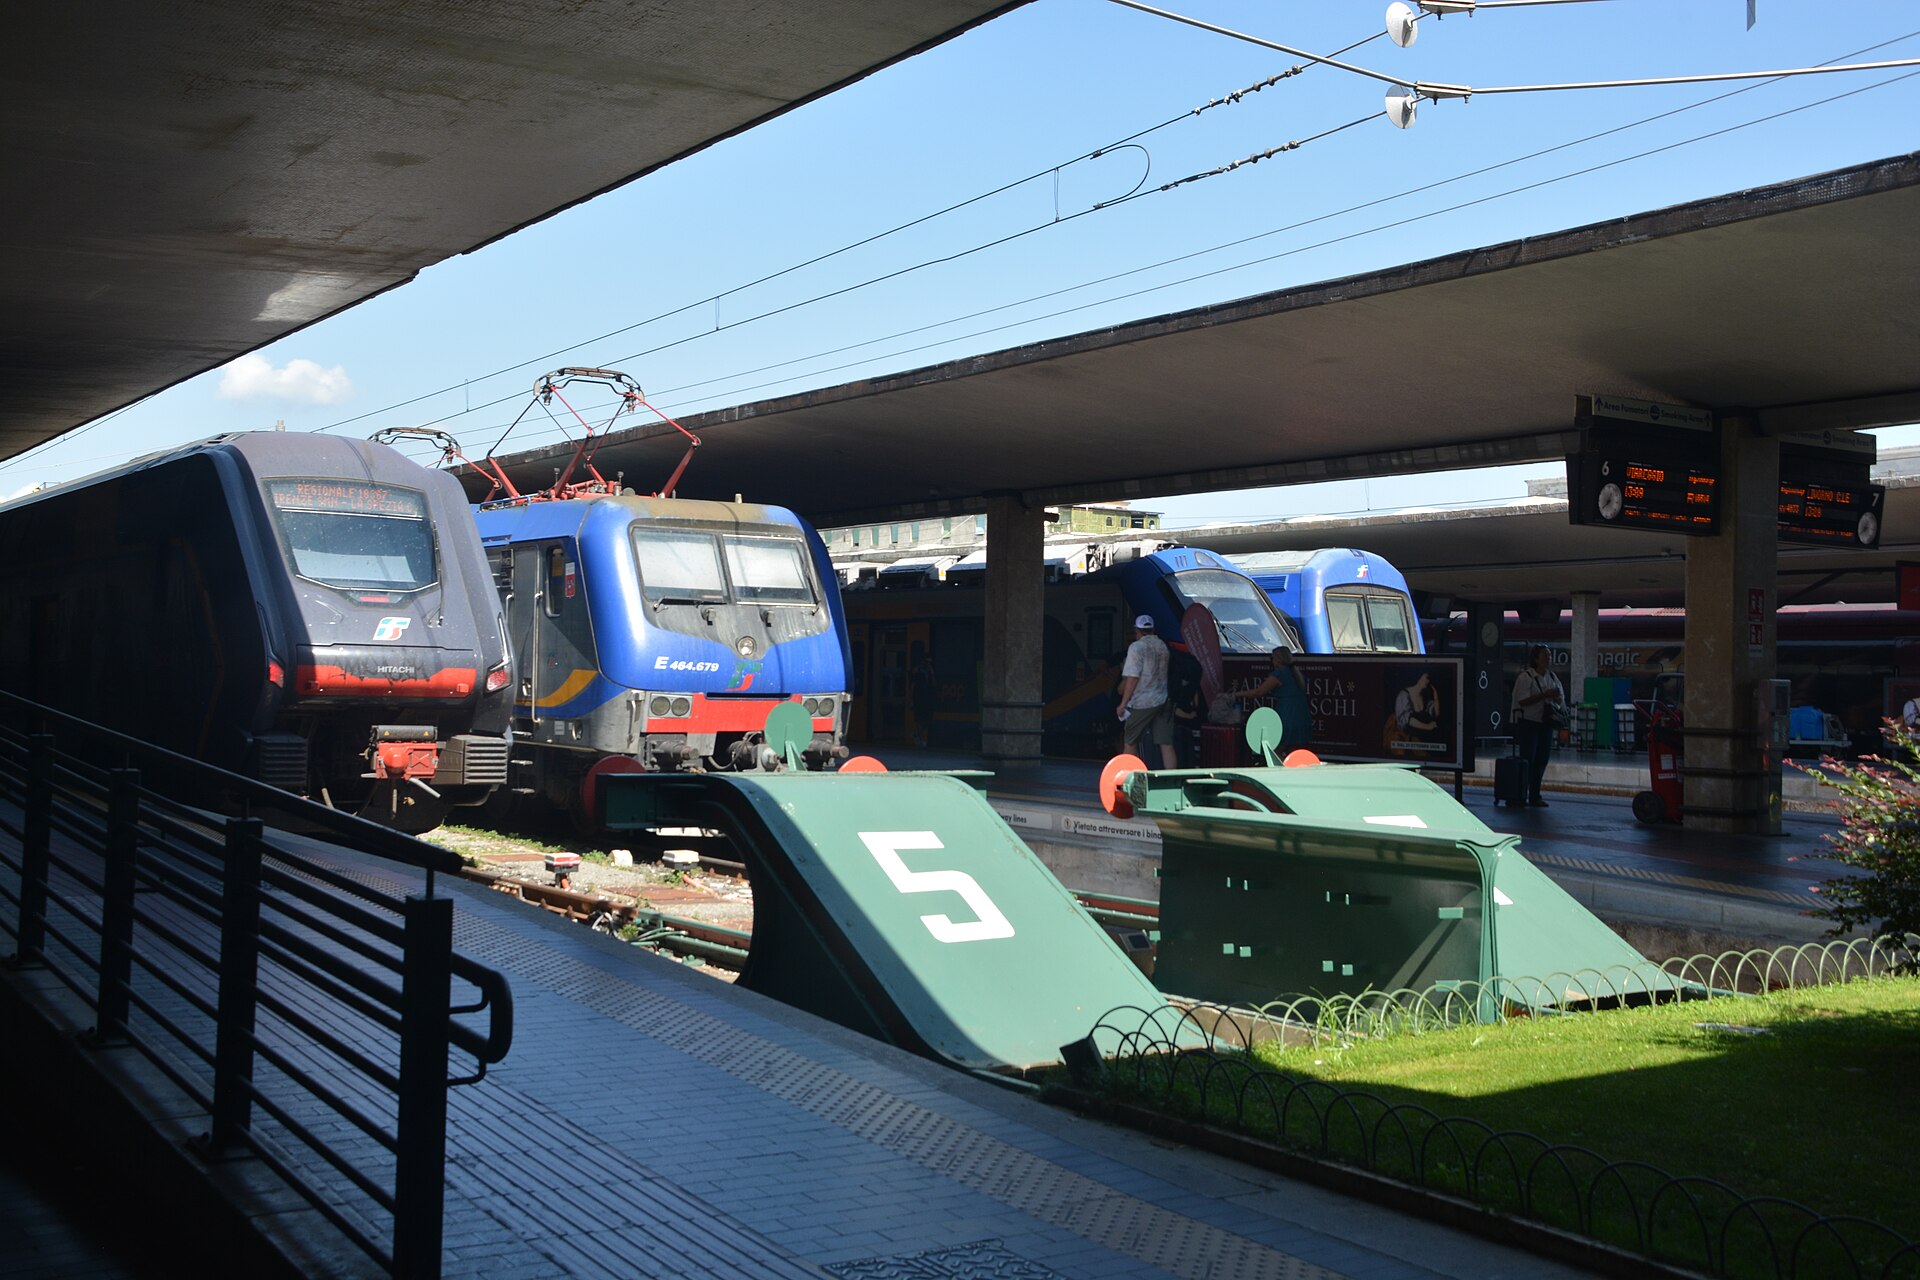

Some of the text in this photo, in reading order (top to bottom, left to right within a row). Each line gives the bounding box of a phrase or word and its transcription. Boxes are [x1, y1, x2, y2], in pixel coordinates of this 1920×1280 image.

[1604, 402, 1620, 411] Area
[1601, 461, 1610, 477] 6
[1625, 466, 1665, 483] VIAREGGIO
[297, 484, 355, 498] REGIONALE
[1871, 492, 1880, 508] 7
[377, 665, 415, 674] HITACHI
[654, 656, 720, 673] E 464.679
[1478, 670, 1489, 690] 8
[1490, 711, 1501, 730] 9
[1013, 813, 1027, 824] lines
[1073, 820, 1097, 832] Vietato
[1098, 824, 1141, 838] attraversare
[857, 831, 1016, 944] 5
